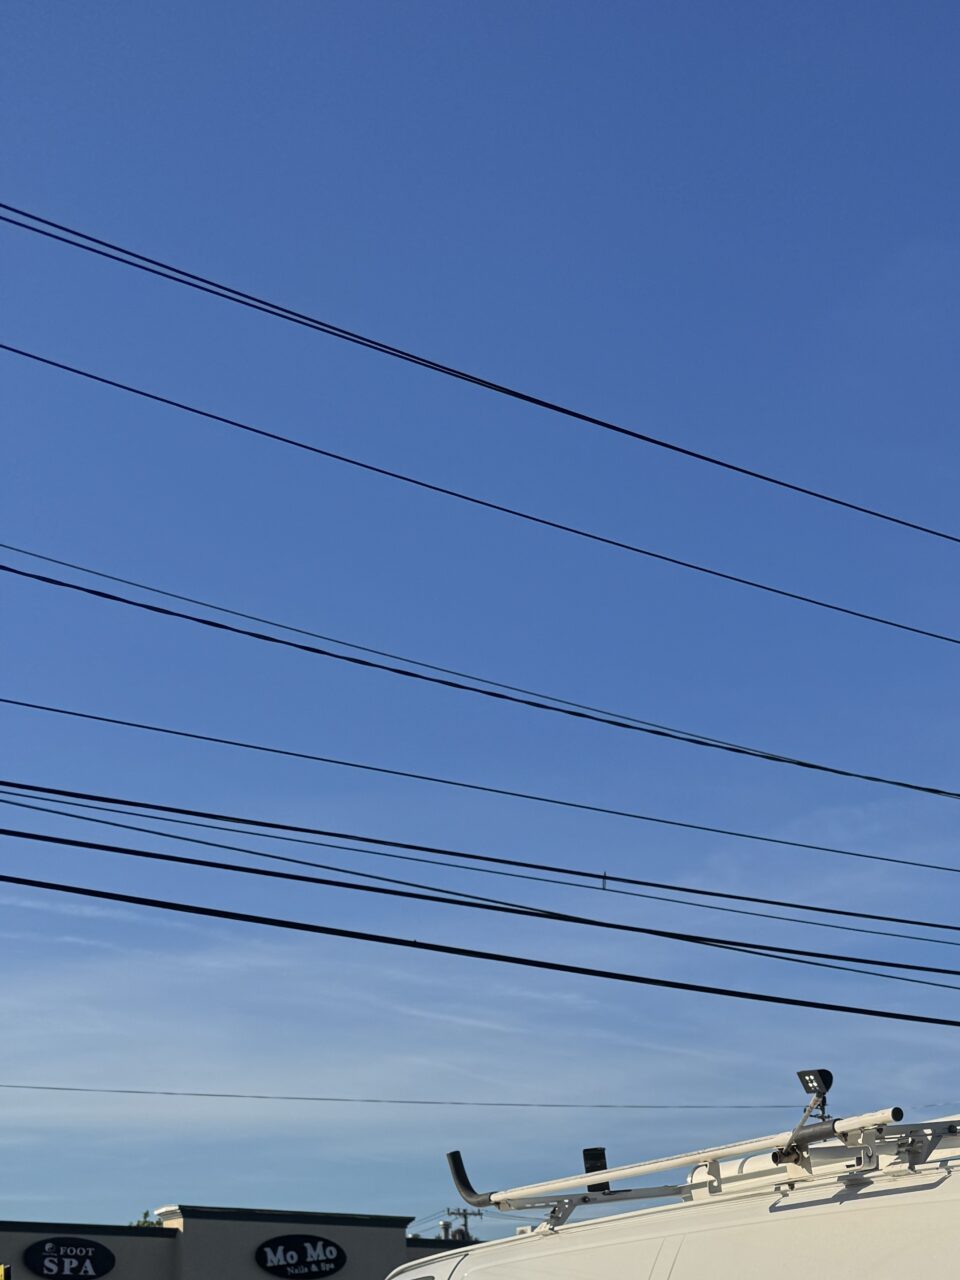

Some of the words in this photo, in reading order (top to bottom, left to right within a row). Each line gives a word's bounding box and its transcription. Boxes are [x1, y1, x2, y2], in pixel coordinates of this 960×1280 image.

[59, 1246, 96, 1256] FOOT
[264, 1245, 299, 1267] Mo
[304, 1240, 338, 1263] Mo
[42, 1257, 97, 1276] SPA
[286, 1264, 309, 1276] Nails
[320, 1262, 336, 1272] Spa
